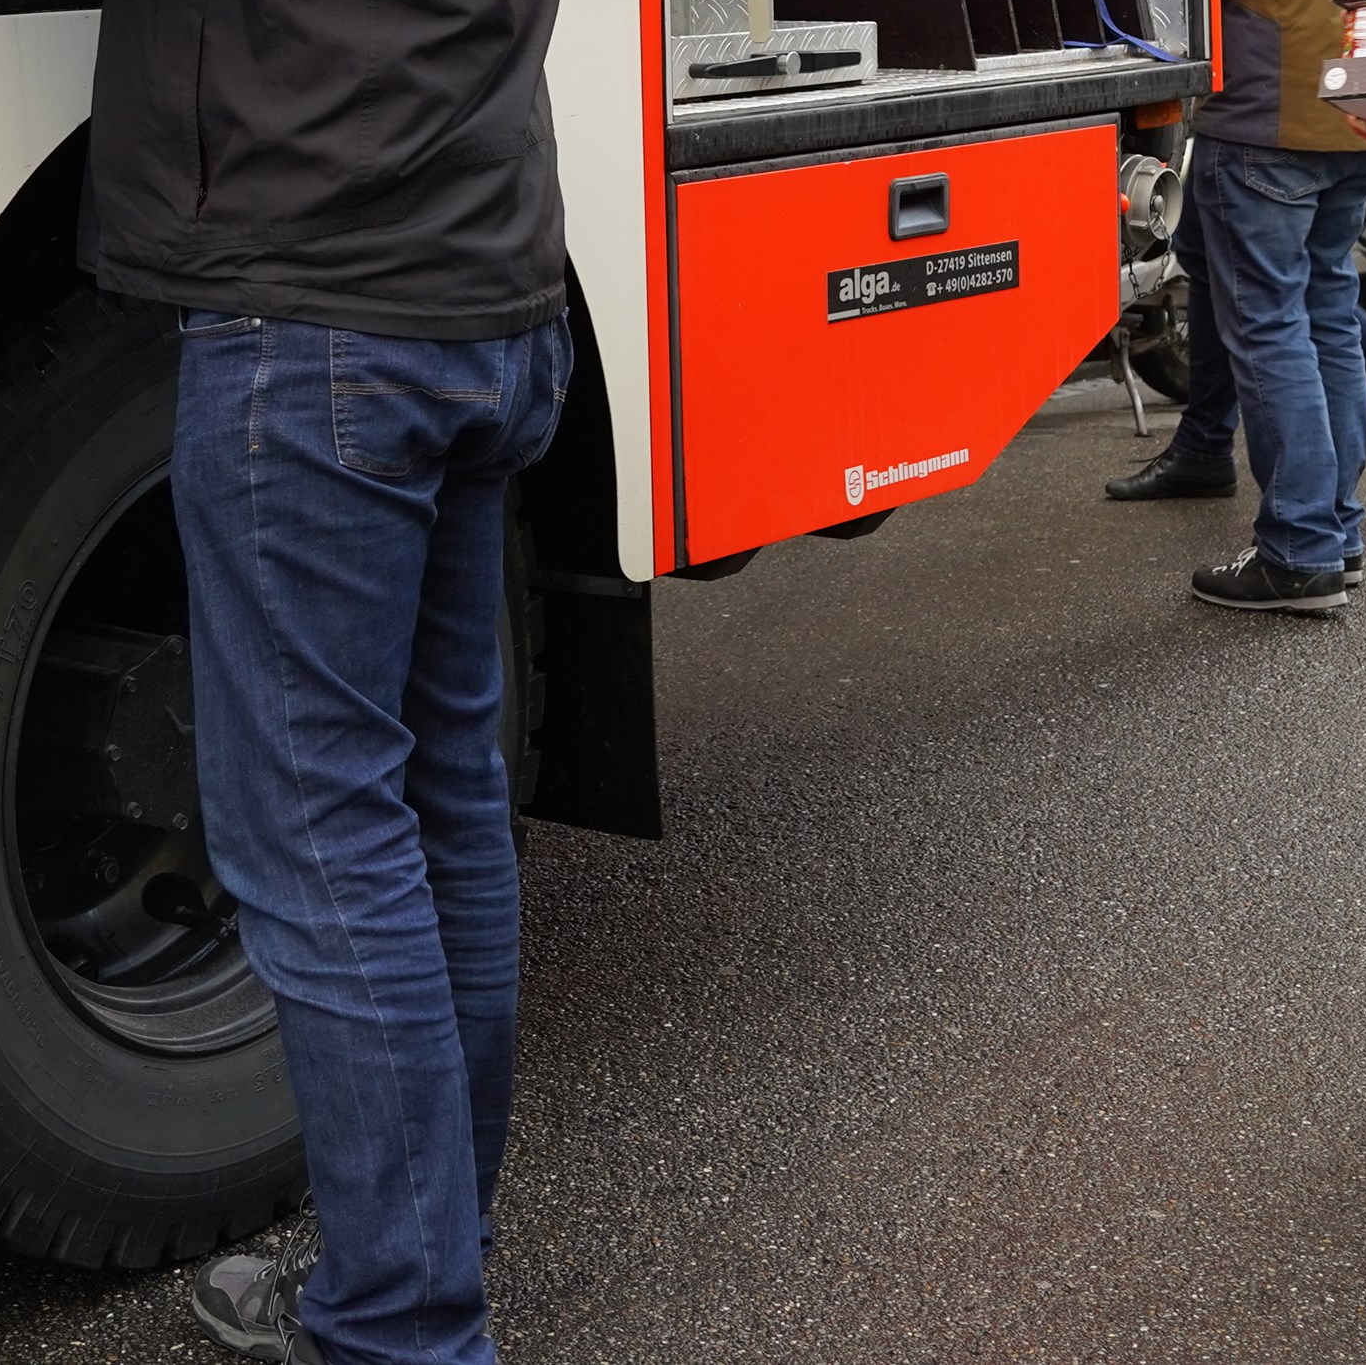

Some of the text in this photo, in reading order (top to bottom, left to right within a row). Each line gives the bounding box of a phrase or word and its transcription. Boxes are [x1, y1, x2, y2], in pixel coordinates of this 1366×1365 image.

[926, 250, 1013, 276] D-27419 Sittensen
[945, 268, 1013, 294] 49(0)4282-570
[865, 448, 969, 491] Schlingmann
